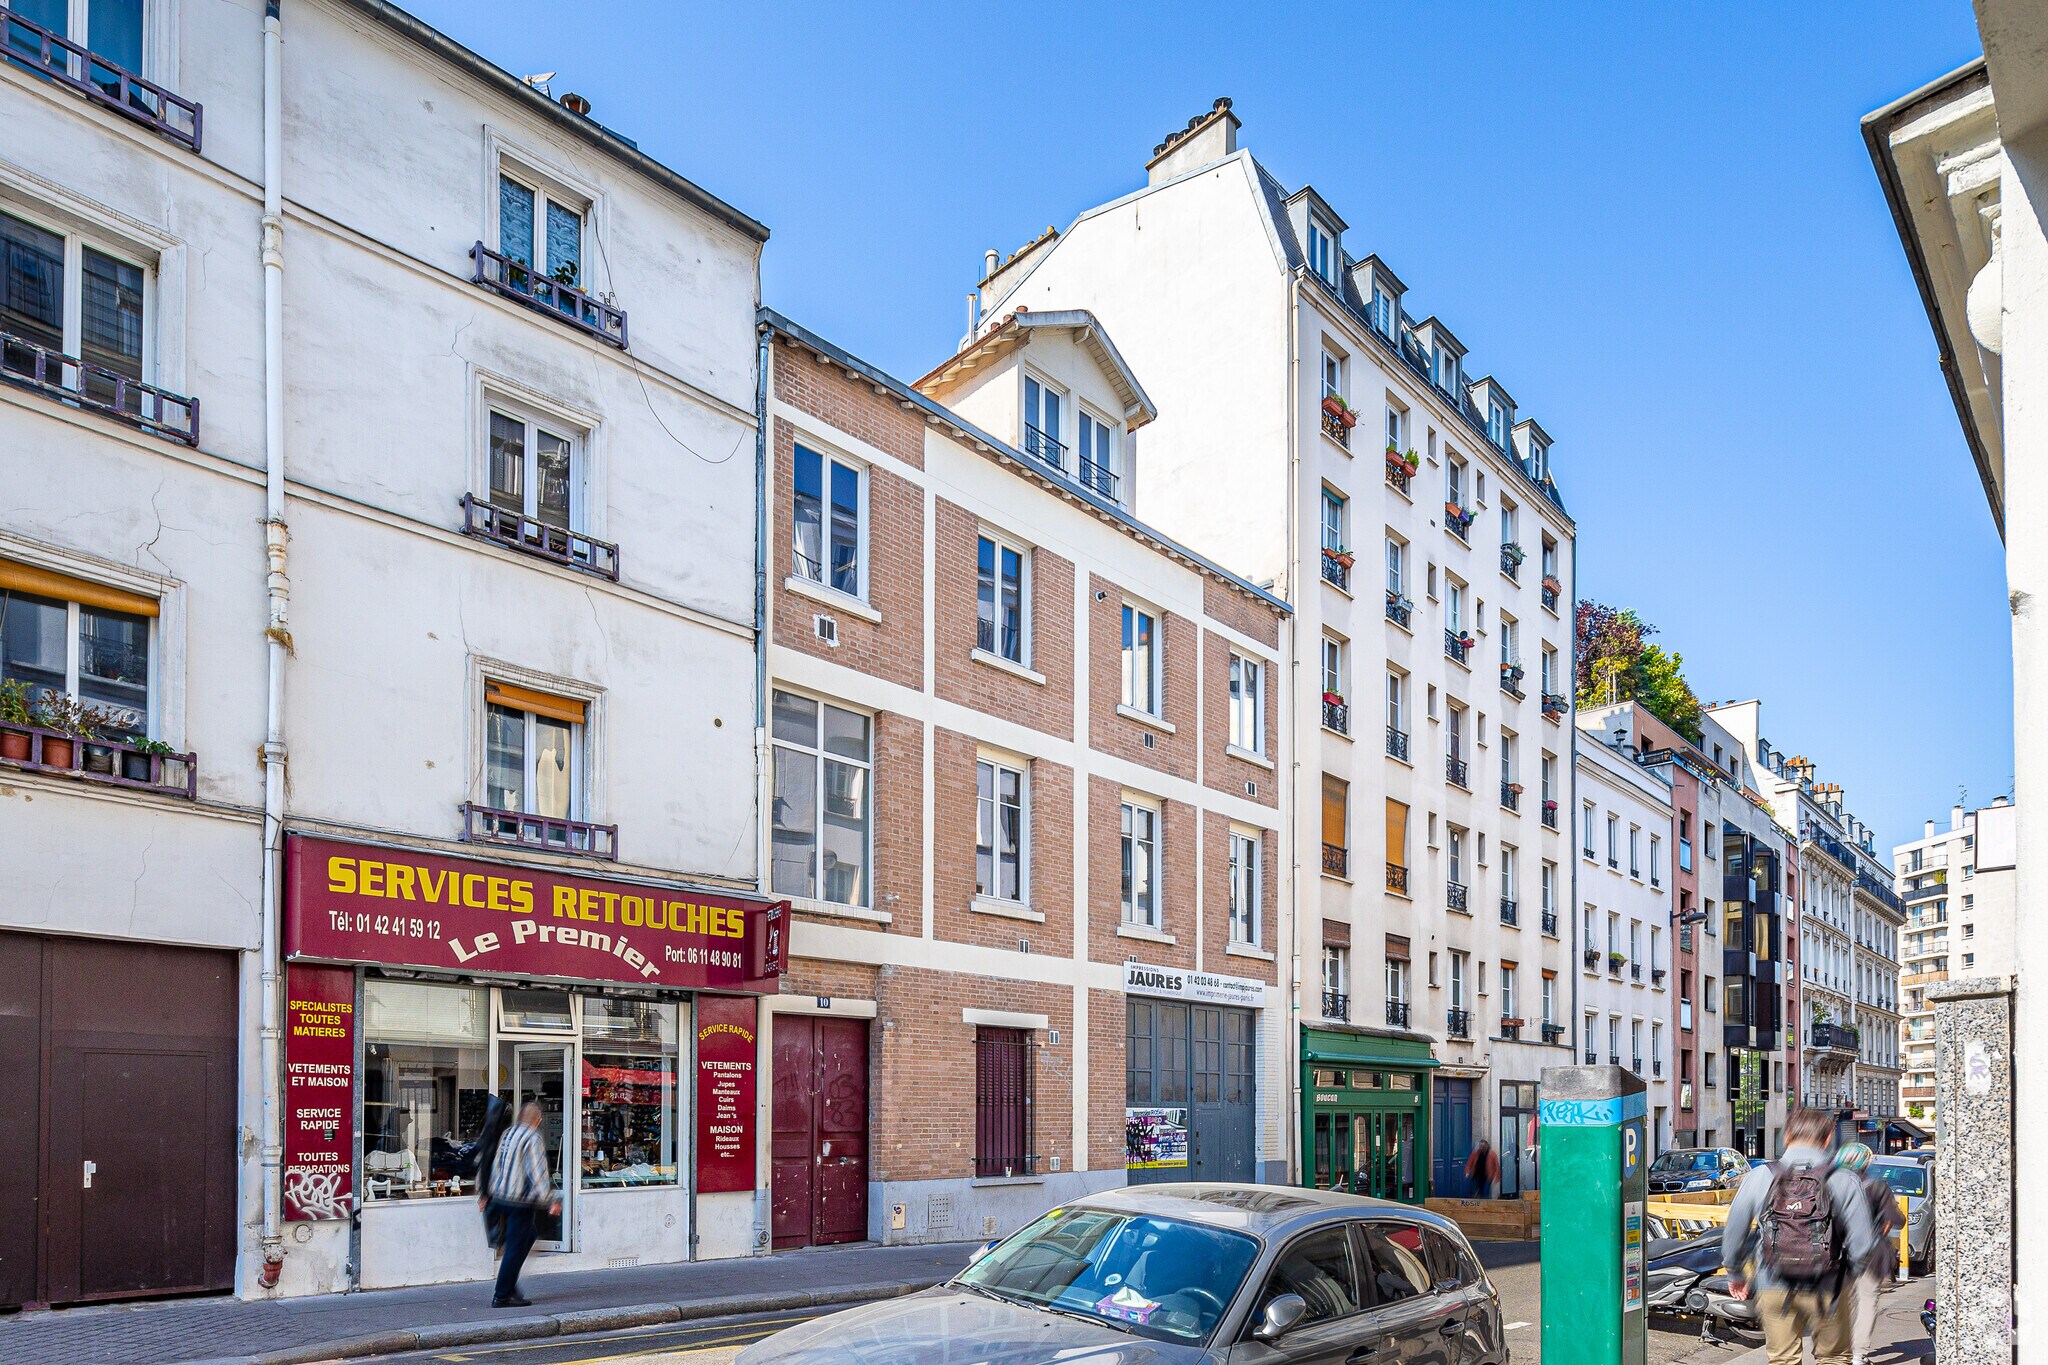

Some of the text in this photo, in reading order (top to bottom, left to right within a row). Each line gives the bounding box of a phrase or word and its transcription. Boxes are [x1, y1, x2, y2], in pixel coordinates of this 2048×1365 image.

[328, 856, 744, 939] SERVICES RETOUCHES
[329, 910, 440, 940] Tél: 01 42 41 59 12
[448, 919, 661, 978] Le Premier
[665, 945, 742, 968] Port: 06 11 48 90 81
[1187, 974, 1193, 984] 01
[1194, 975, 1200, 985] 42
[1201, 976, 1206, 986] 03
[290, 1000, 353, 1014] SPECIALISTES
[820, 997, 829, 1007] 10
[300, 1013, 341, 1025] TOUTES
[293, 1026, 346, 1038] MATIERES
[699, 1023, 754, 1043] SERVICE RAPIDE
[288, 1063, 351, 1075] VETEMENTS
[701, 1061, 752, 1071] VETEMENTS
[291, 1076, 349, 1087] ET MAISON
[296, 1108, 341, 1118] SERVICE
[300, 1120, 340, 1130] RAPIDE
[709, 1125, 743, 1134] MAISON
[297, 1152, 339, 1162] TOUTES
